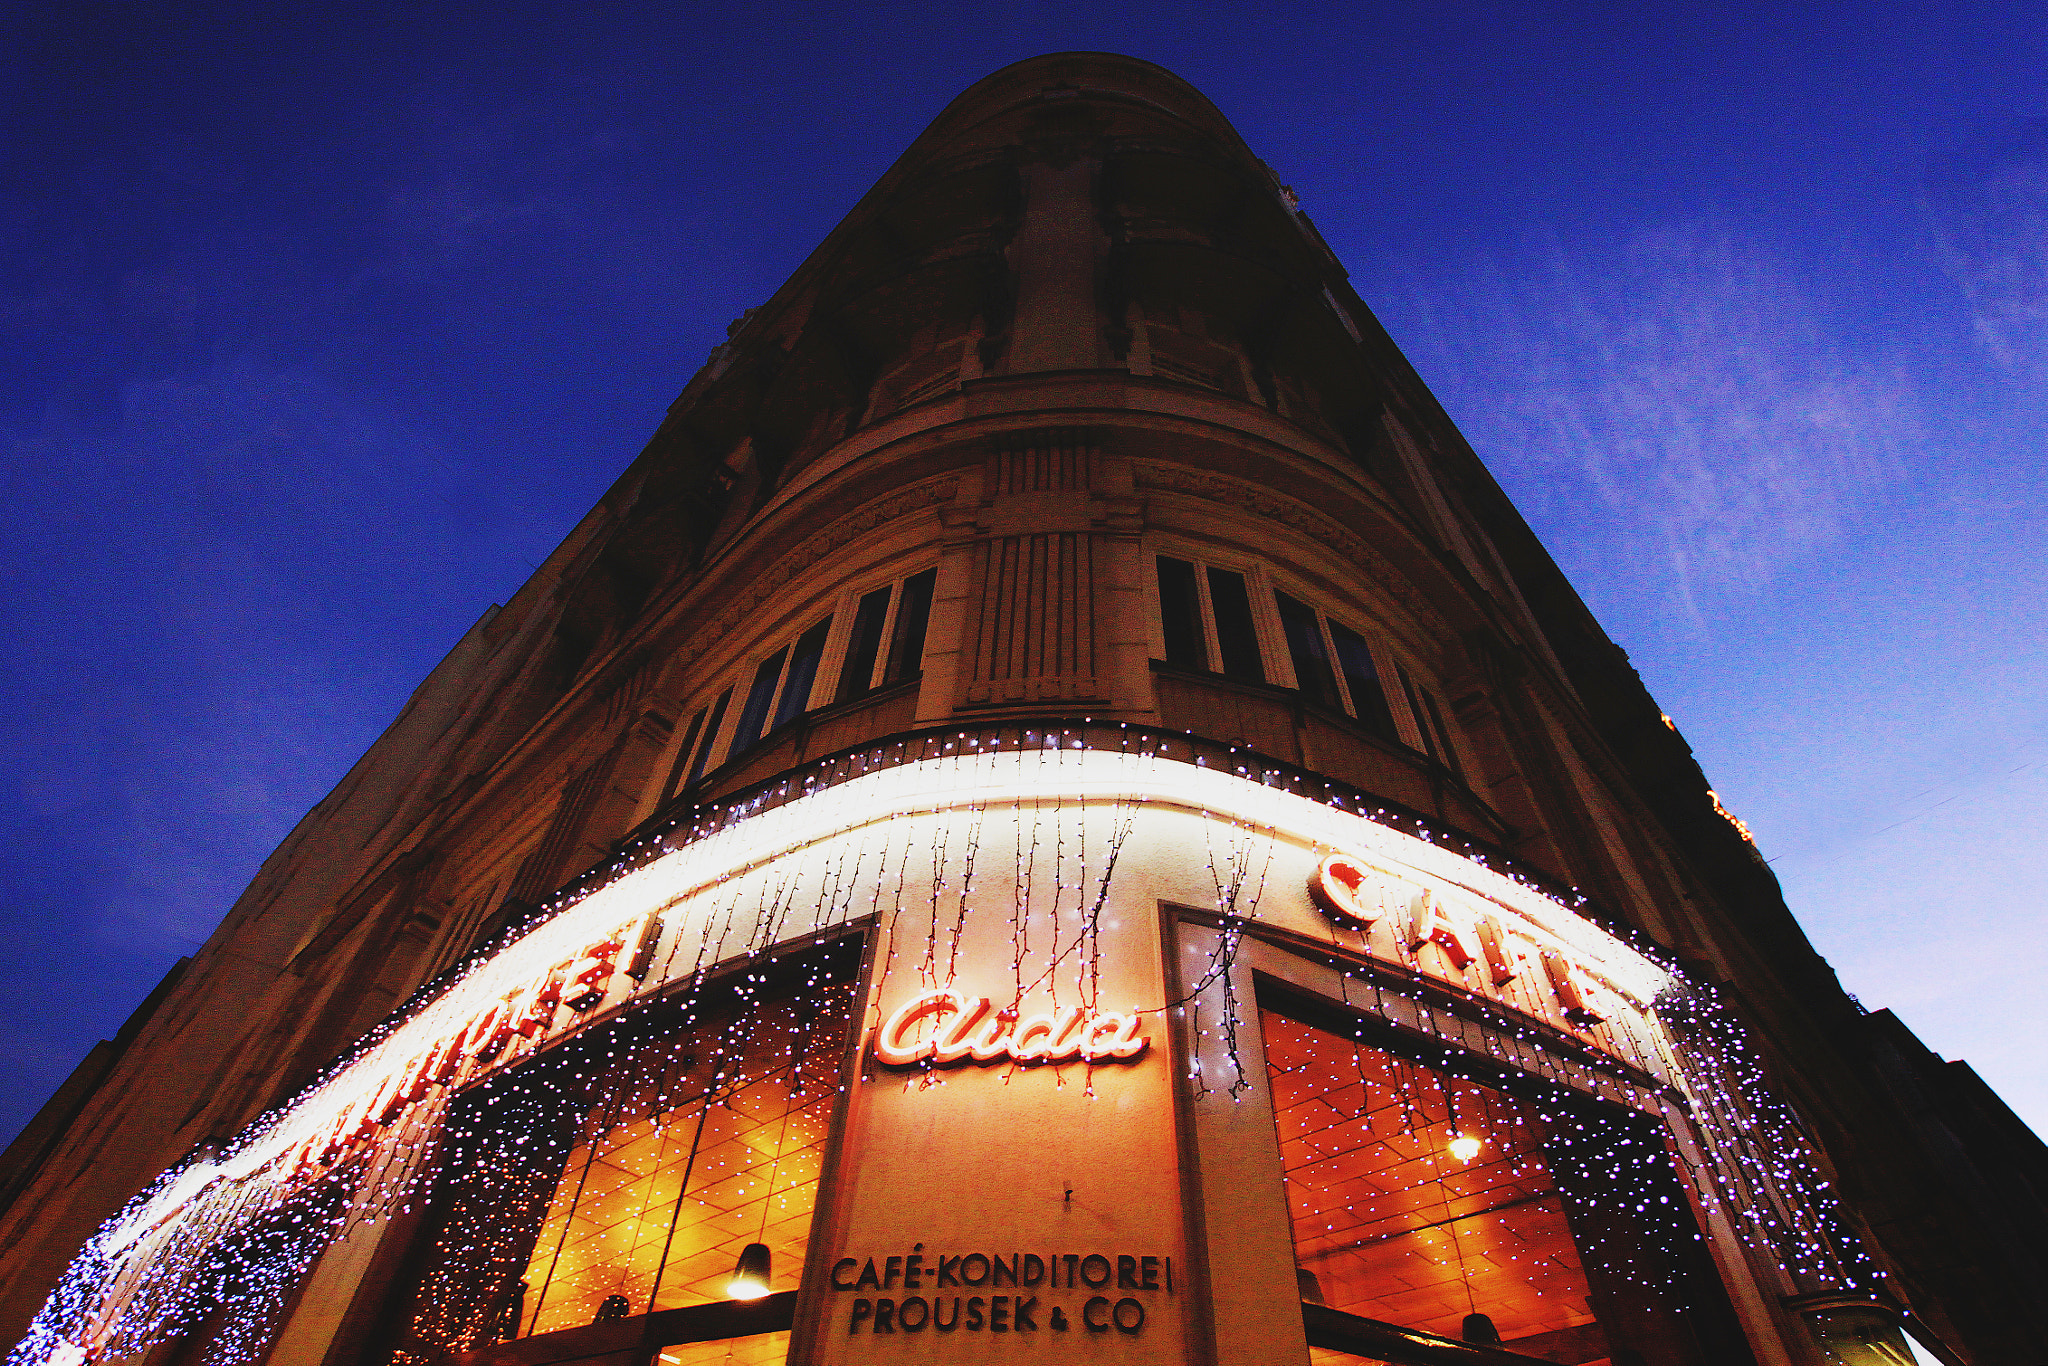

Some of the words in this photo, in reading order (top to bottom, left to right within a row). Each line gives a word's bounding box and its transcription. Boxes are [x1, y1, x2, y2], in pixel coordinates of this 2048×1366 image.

[830, 1242, 1173, 1291] CAFÉ-KONDITOREI
[849, 1296, 1038, 1334] PROUSEK
[1050, 1306, 1067, 1331] &
[1083, 1297, 1145, 1335] CO
